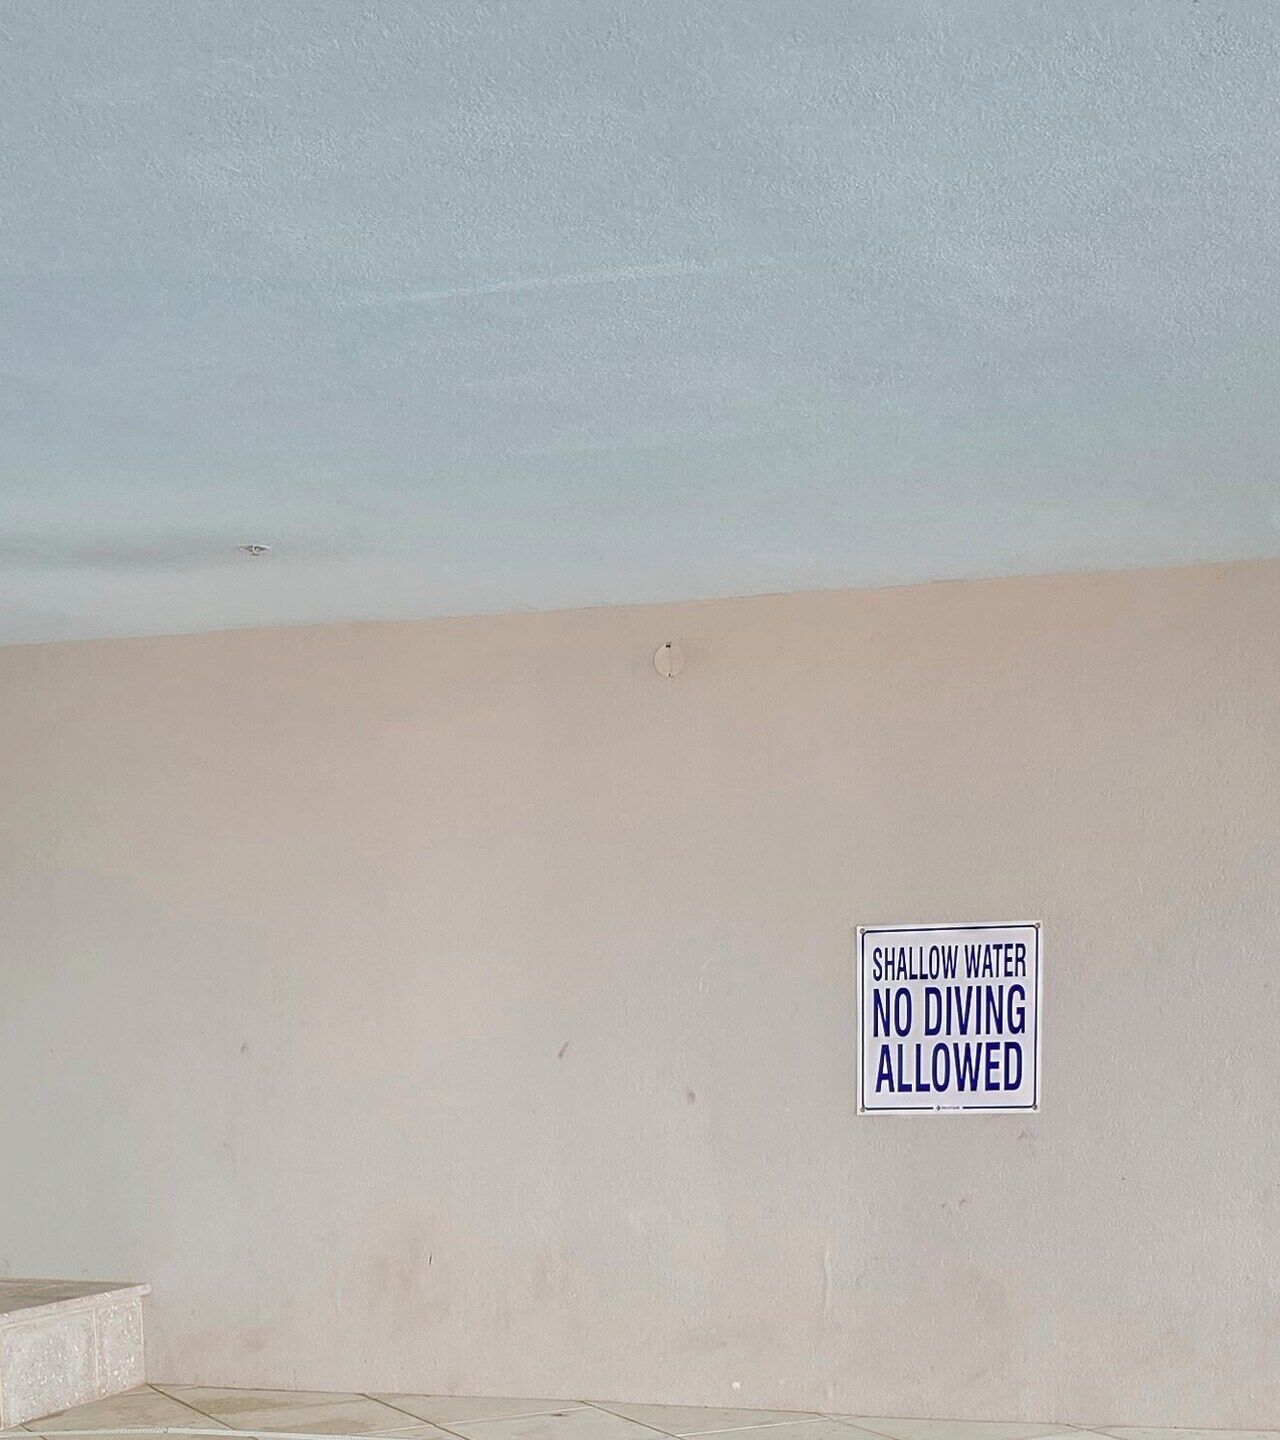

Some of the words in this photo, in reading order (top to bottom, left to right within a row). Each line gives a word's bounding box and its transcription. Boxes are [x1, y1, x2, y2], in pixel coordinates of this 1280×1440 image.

[872, 945, 958, 982] SHALLOW
[965, 943, 1026, 978] WATER
[873, 987, 912, 1038] NO
[924, 984, 1026, 1036] DIVING
[875, 1041, 1023, 1093] ALLOWED
